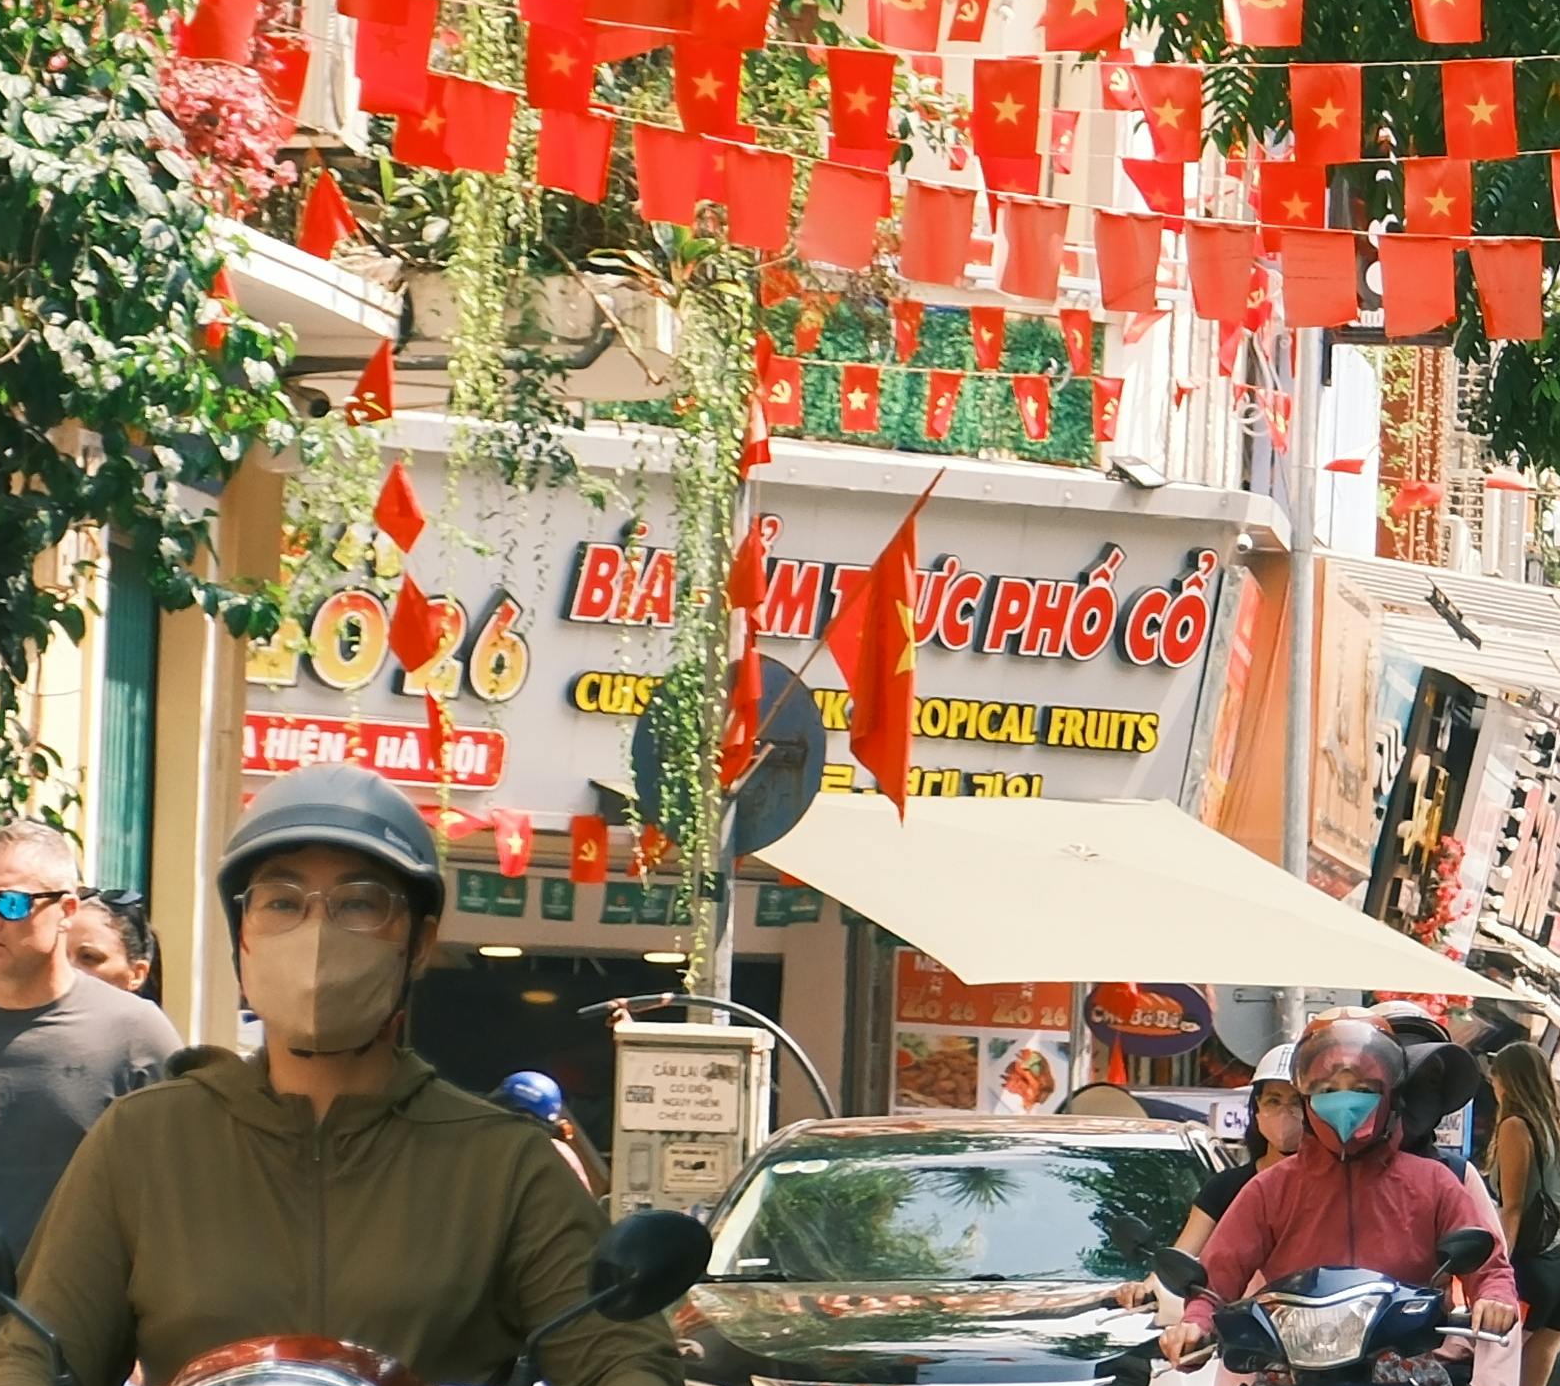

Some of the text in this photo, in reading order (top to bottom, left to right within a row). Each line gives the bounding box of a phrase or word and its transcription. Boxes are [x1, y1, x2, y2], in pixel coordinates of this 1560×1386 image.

[982, 546, 1127, 661] PHỐ
[1125, 550, 1218, 669] CỔ
[374, 731, 422, 771] HÀ
[1046, 707, 1160, 753] FRUITS
